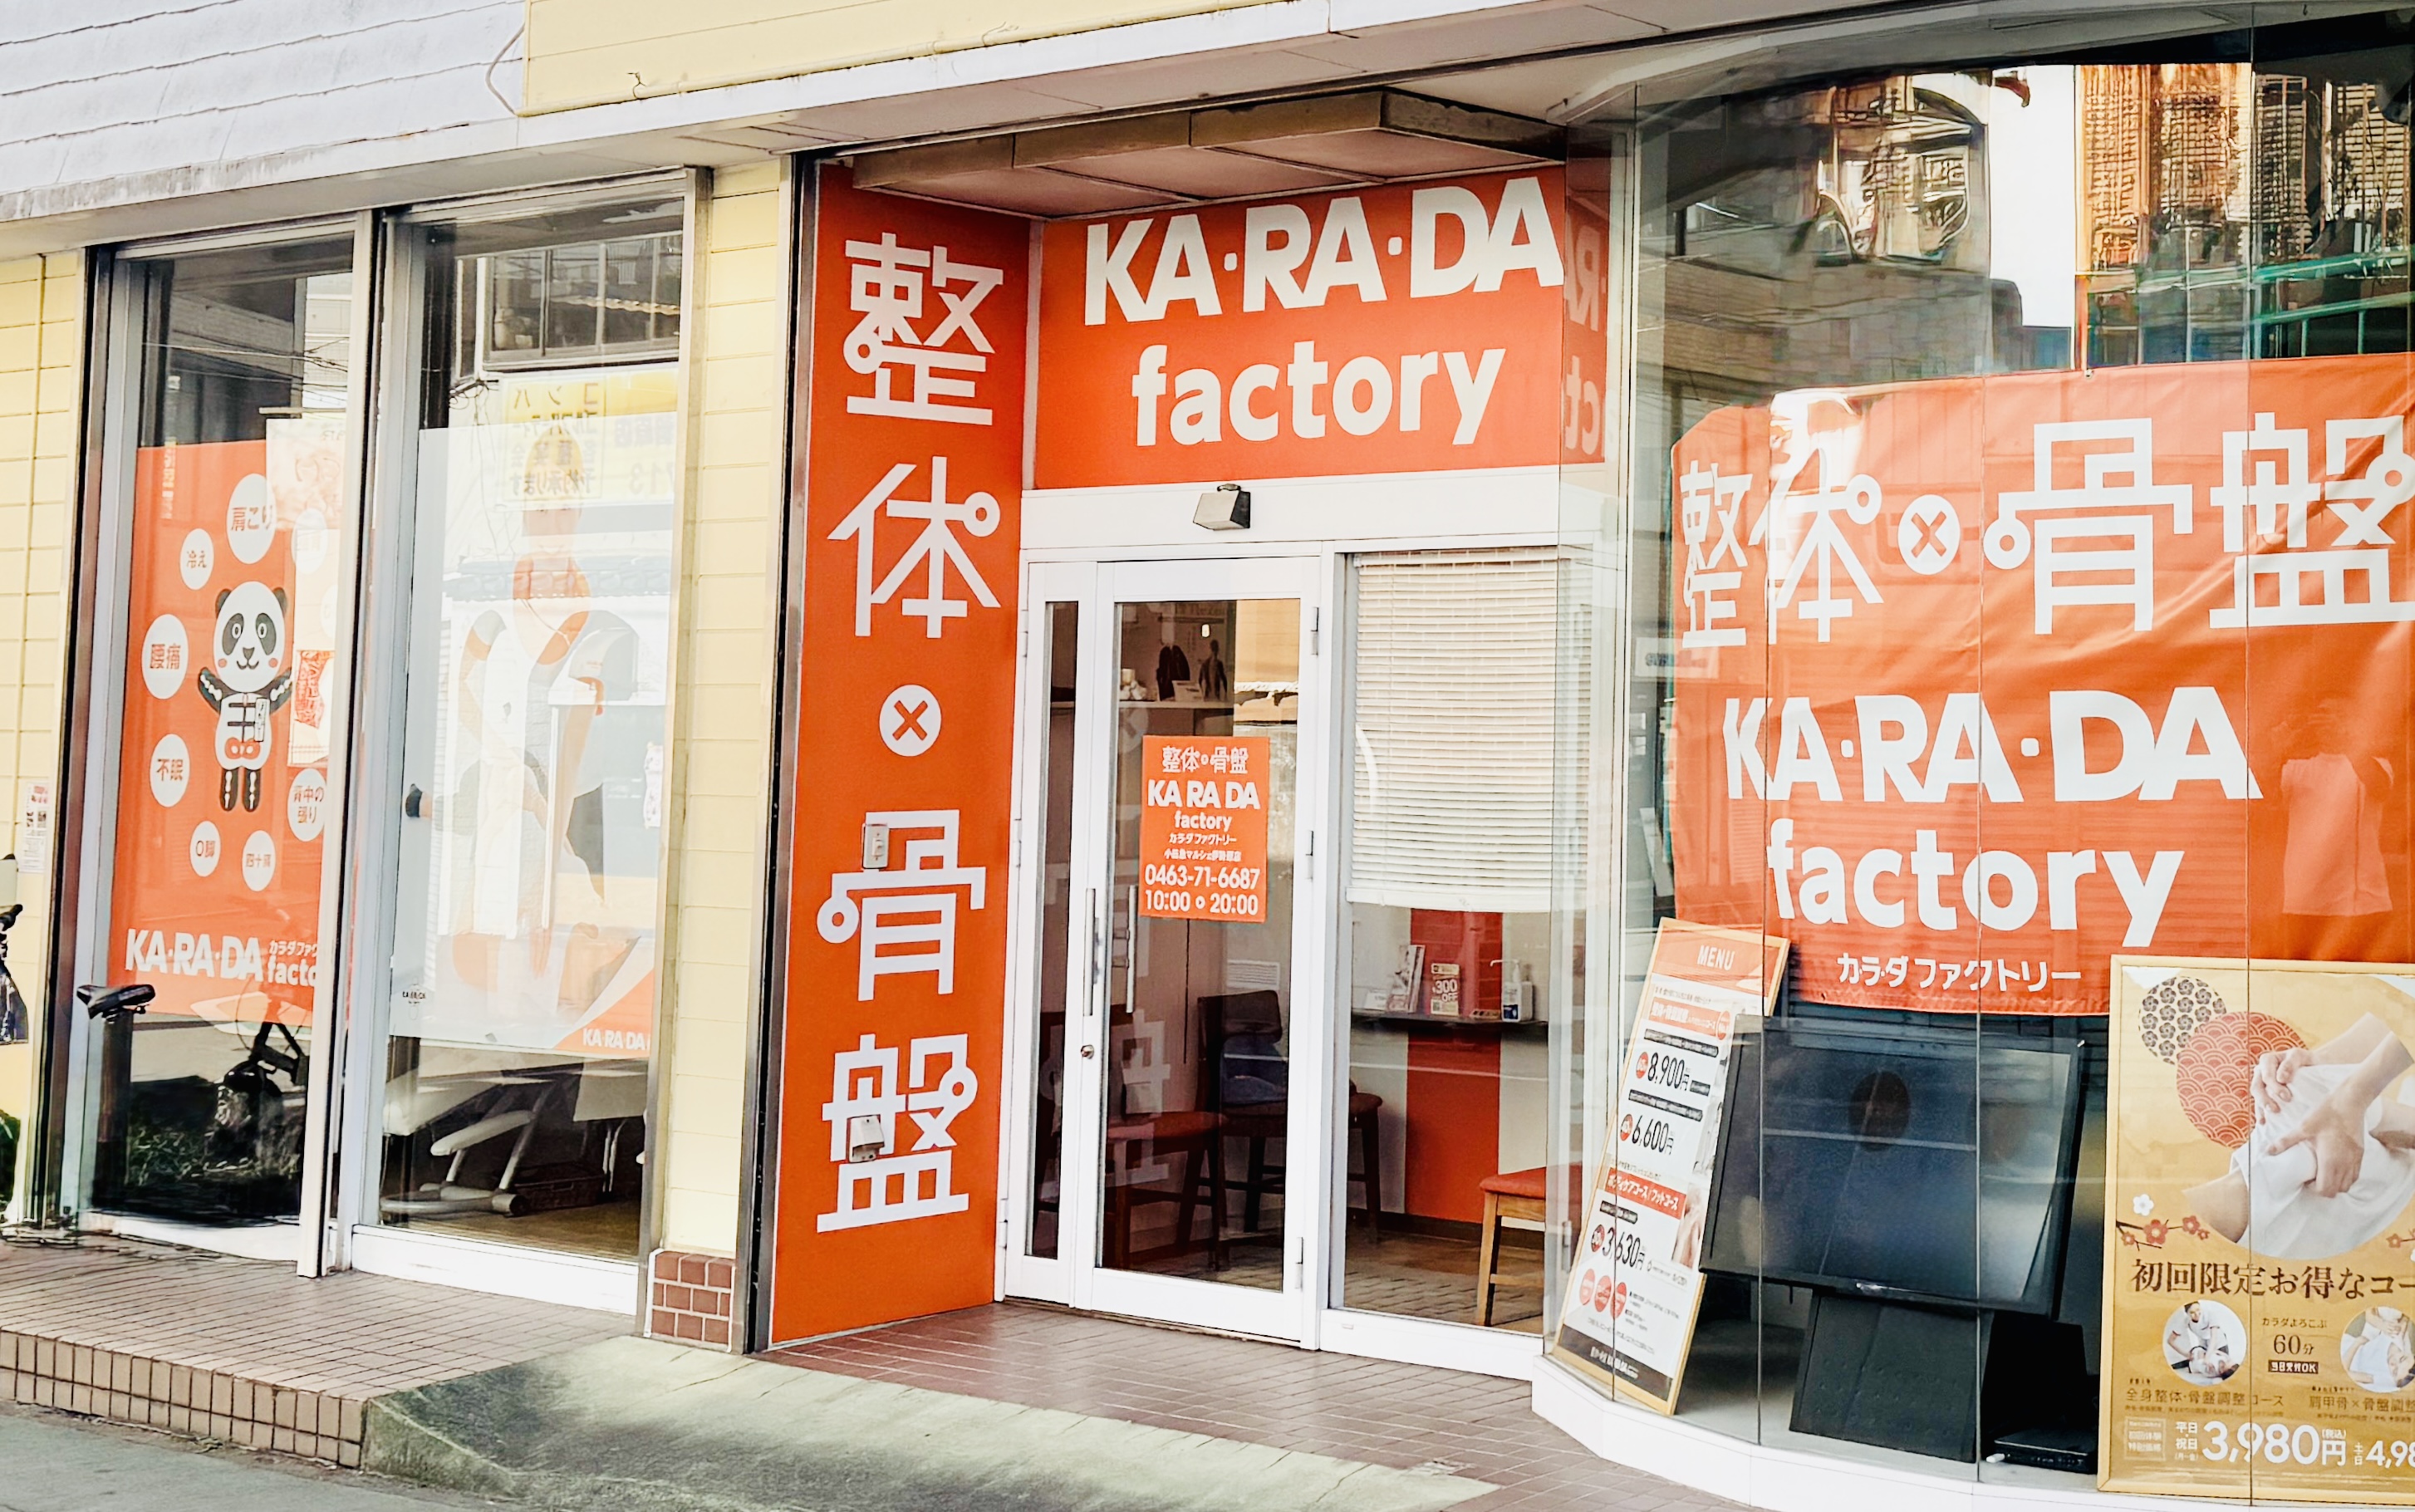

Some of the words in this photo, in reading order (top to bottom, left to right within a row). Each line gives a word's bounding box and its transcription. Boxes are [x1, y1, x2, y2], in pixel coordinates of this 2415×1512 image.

[1131, 341, 1505, 446] factory
[231, 504, 272, 532] 肩こり
[156, 758, 184, 781] 不眠
[1174, 810, 1232, 832] factory
[1145, 863, 1260, 890] 0463-71-6687
[1766, 818, 2185, 947] factory
[1145, 889, 1190, 912] 10:00
[1210, 892, 1259, 916] 20:00
[1696, 945, 1735, 970] MENU
[2273, 1333, 2314, 1356] 60分
